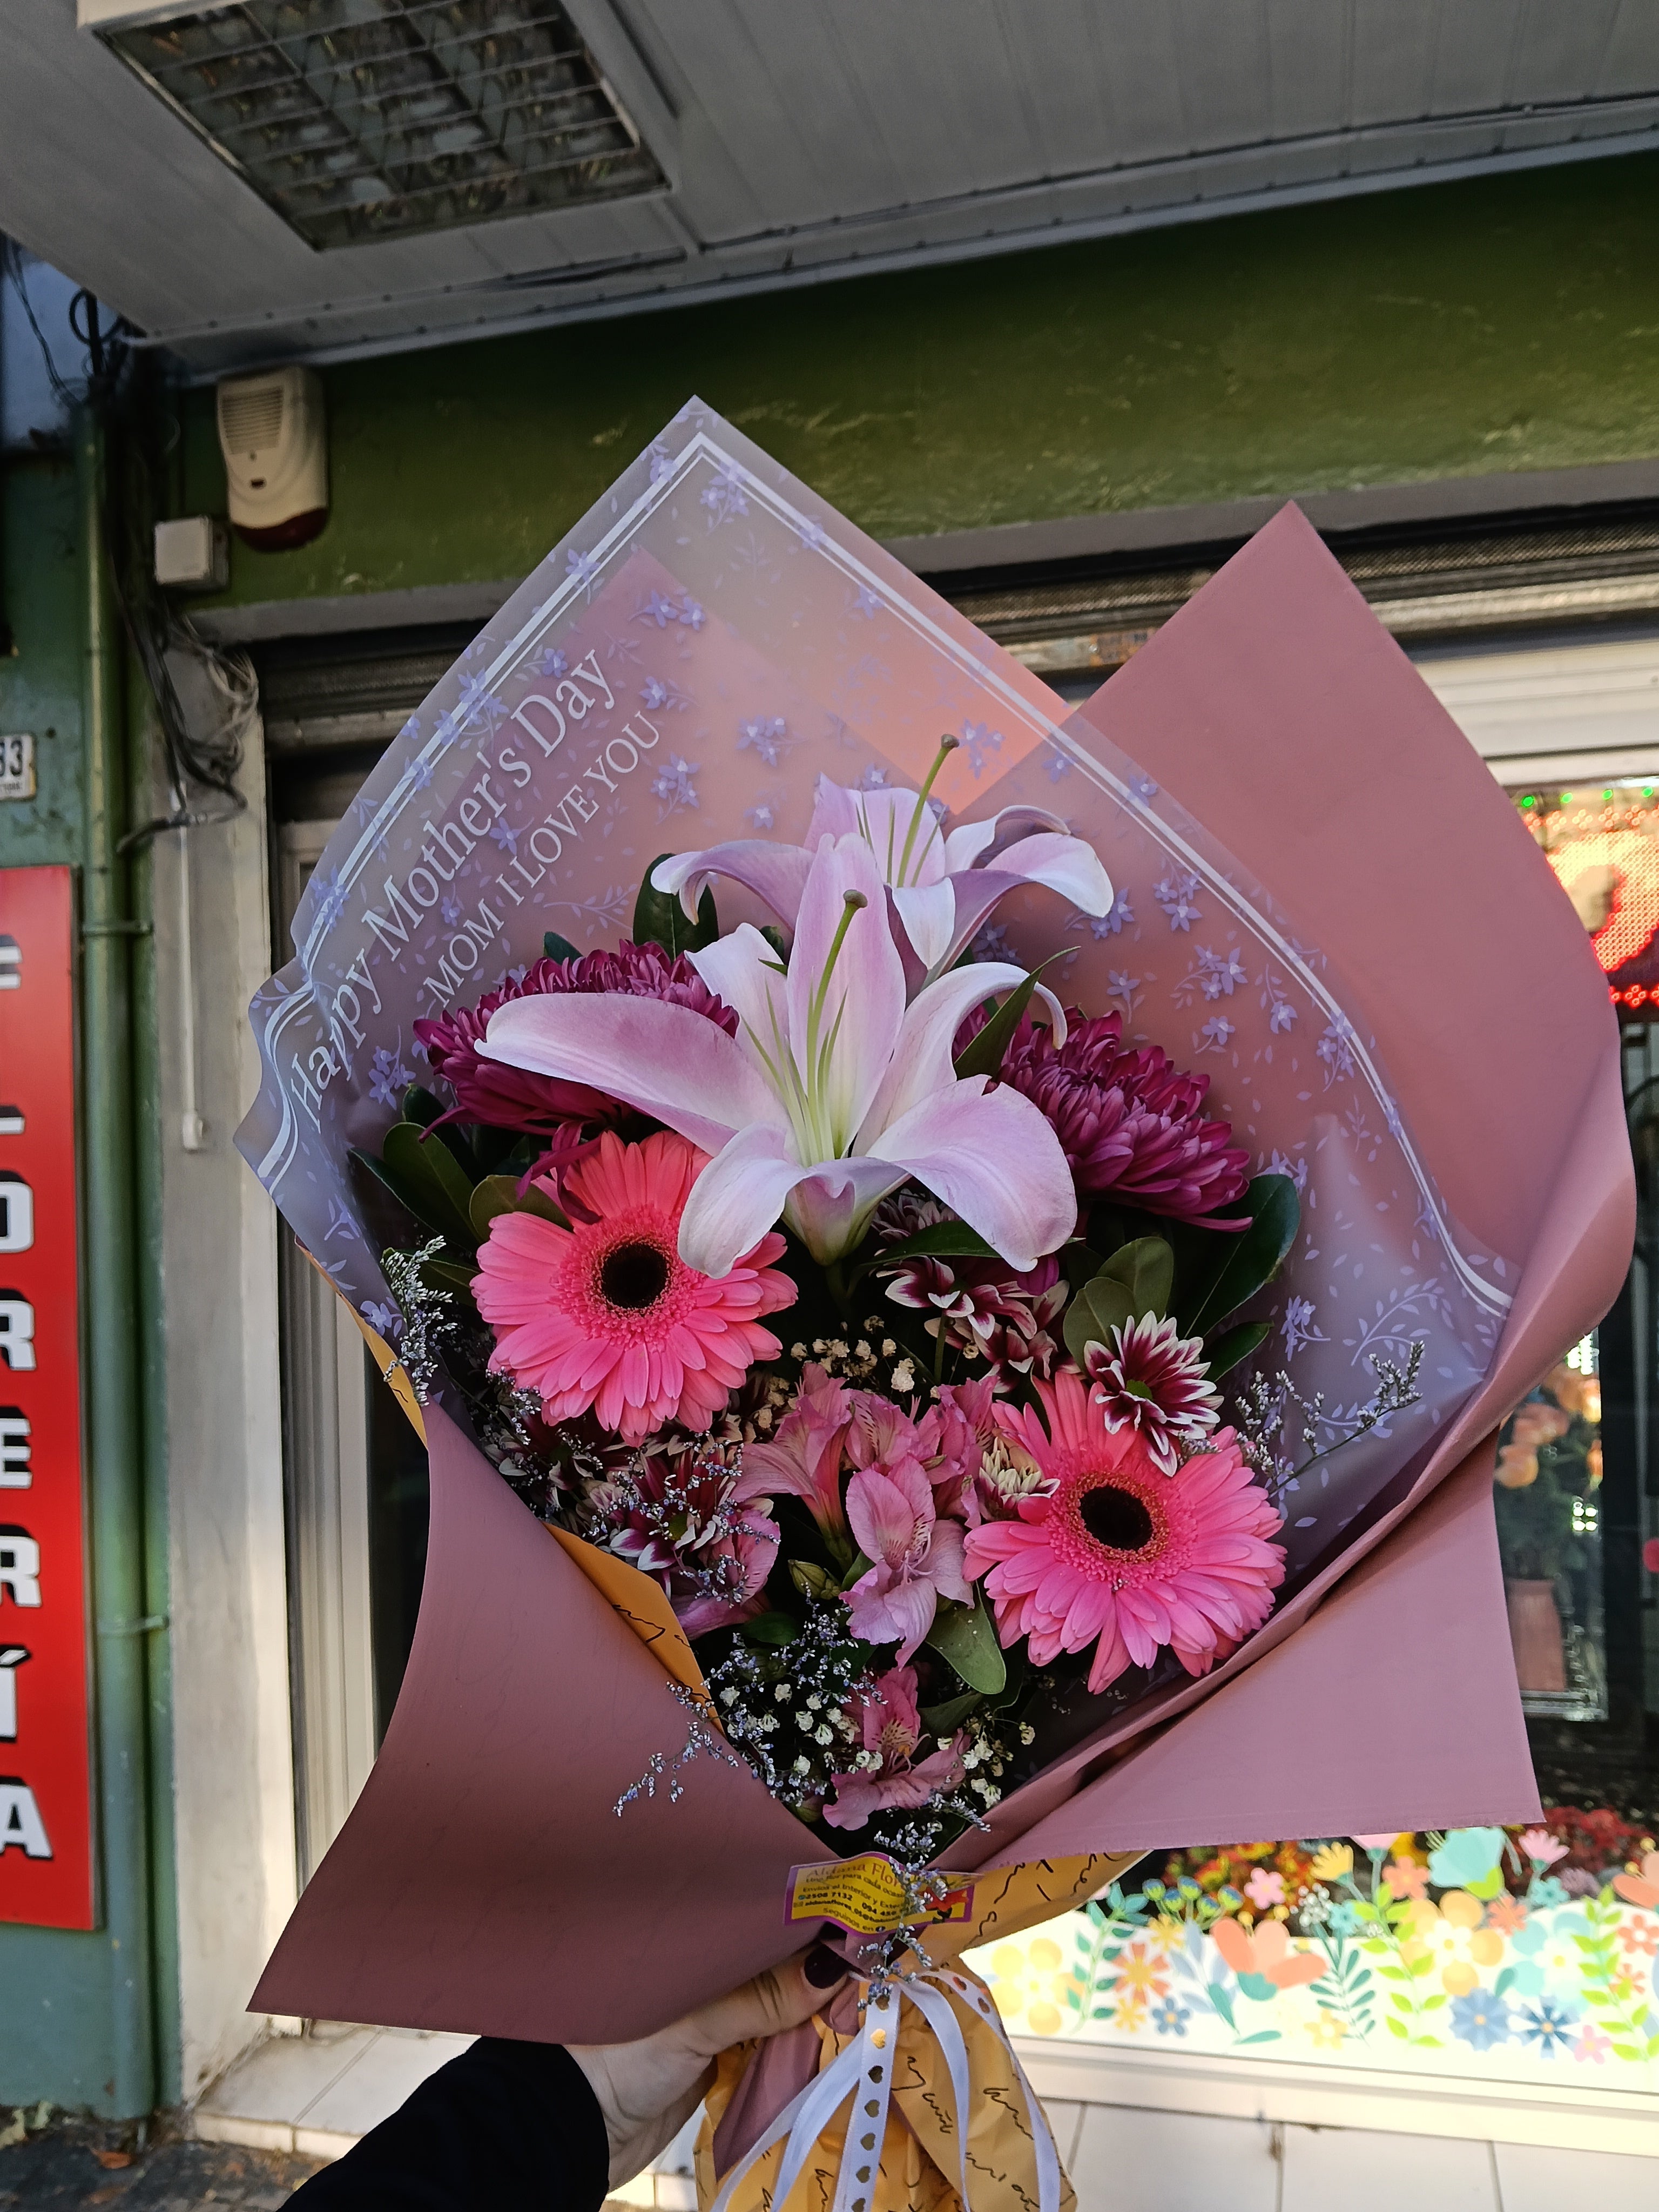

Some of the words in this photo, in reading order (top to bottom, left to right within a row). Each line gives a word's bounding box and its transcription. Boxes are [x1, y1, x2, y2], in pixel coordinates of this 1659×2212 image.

[583, 711, 662, 794] YOU
[508, 784, 601, 889] LOVE
[291, 948, 382, 1133] Happy
[361, 750, 532, 962] Mother's
[511, 649, 616, 758] Day
[496, 873, 525, 907] I
[422, 901, 505, 1010] MOM
[873, 1897, 878, 1905] y
